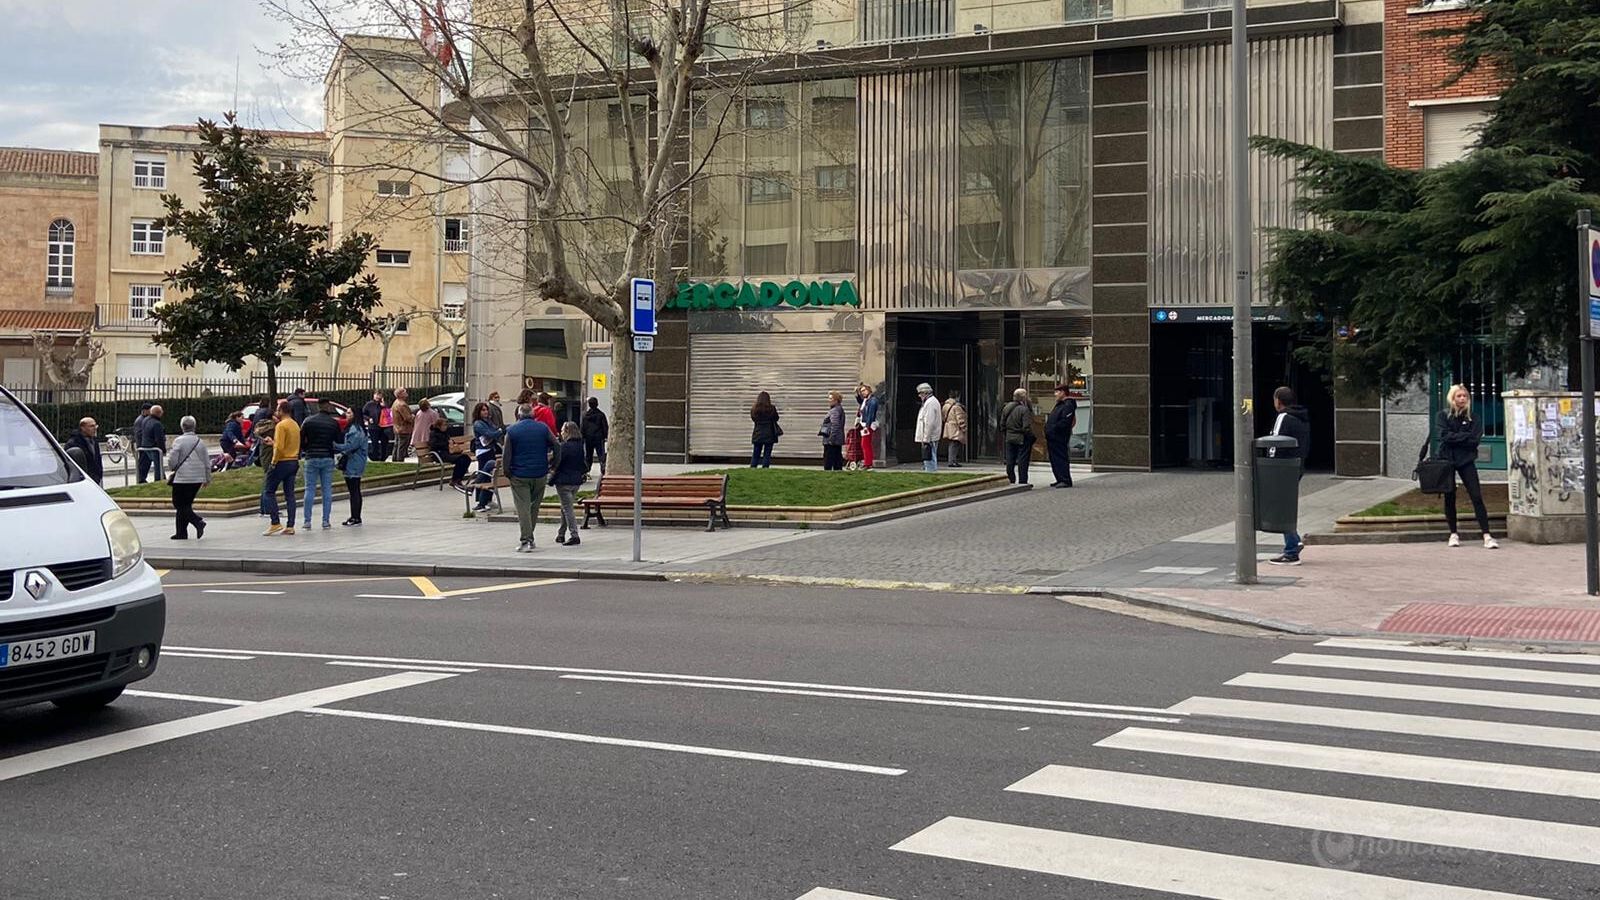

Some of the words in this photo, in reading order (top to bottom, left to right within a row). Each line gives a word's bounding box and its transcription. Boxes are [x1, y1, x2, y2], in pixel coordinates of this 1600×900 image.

[666, 280, 861, 309] ERCADONA
[12, 641, 56, 662] 8452
[62, 635, 91, 655] GDW
